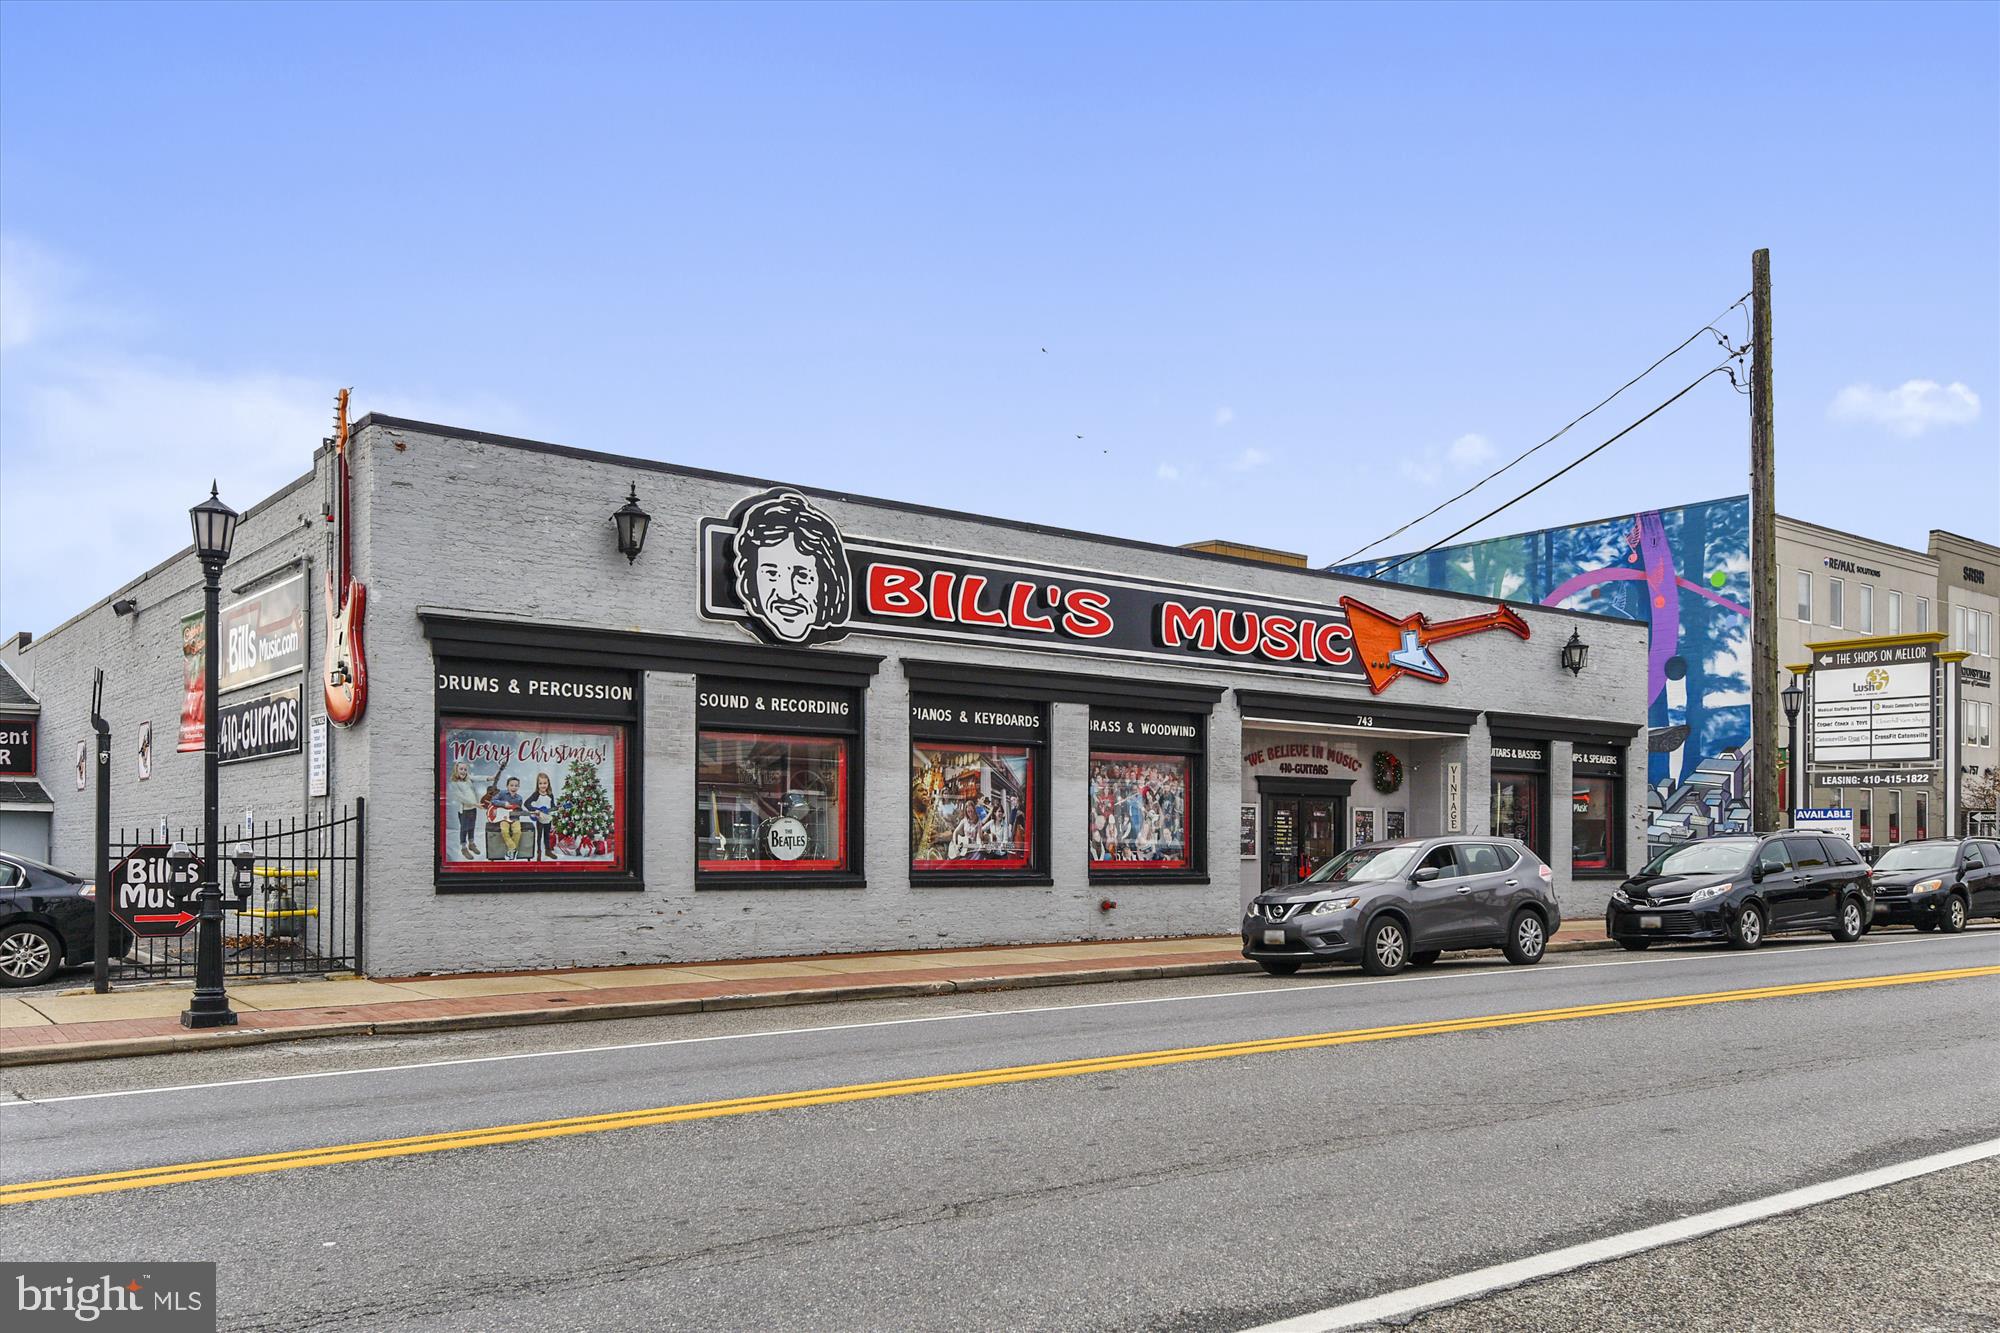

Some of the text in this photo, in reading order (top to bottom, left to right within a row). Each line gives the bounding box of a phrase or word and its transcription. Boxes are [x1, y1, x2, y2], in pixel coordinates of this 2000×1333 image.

[1829, 558, 1855, 573] RE/MAX
[867, 563, 1353, 665] BILL'S MUSIC
[229, 624, 298, 674] Bills Music.com
[1837, 647, 1926, 665] THE SHOPS ON MELLOR
[439, 675, 632, 700] DRUMS & PERCUSSION
[1853, 681, 1875, 692] Lush
[700, 693, 849, 715] SOUND & RECORDING
[221, 699, 297, 752] 410-GUITARS
[960, 711, 968, 723] &
[974, 712, 1040, 728] KEYBOARDS
[1357, 716, 1373, 727] 743
[1127, 722, 1134, 733] &
[1141, 723, 1196, 737] WOODWIND
[451, 736, 608, 765] Merry Christmas!
[1267, 744, 1309, 760] BELIEVE
[1312, 745, 1324, 759] IN
[1512, 749, 1517, 758] &
[1518, 749, 1541, 760] BASSES
[1583, 754, 1588, 763] &
[1589, 754, 1616, 765] SPEAKERS
[1279, 763, 1328, 775] 410-GUITARS
[1822, 774, 1929, 785] LEASING: 410-415-1822
[1450, 766, 1458, 829] VINTAGE
[1797, 810, 1851, 819] AVAILABLE
[120, 883, 205, 908] Musc
